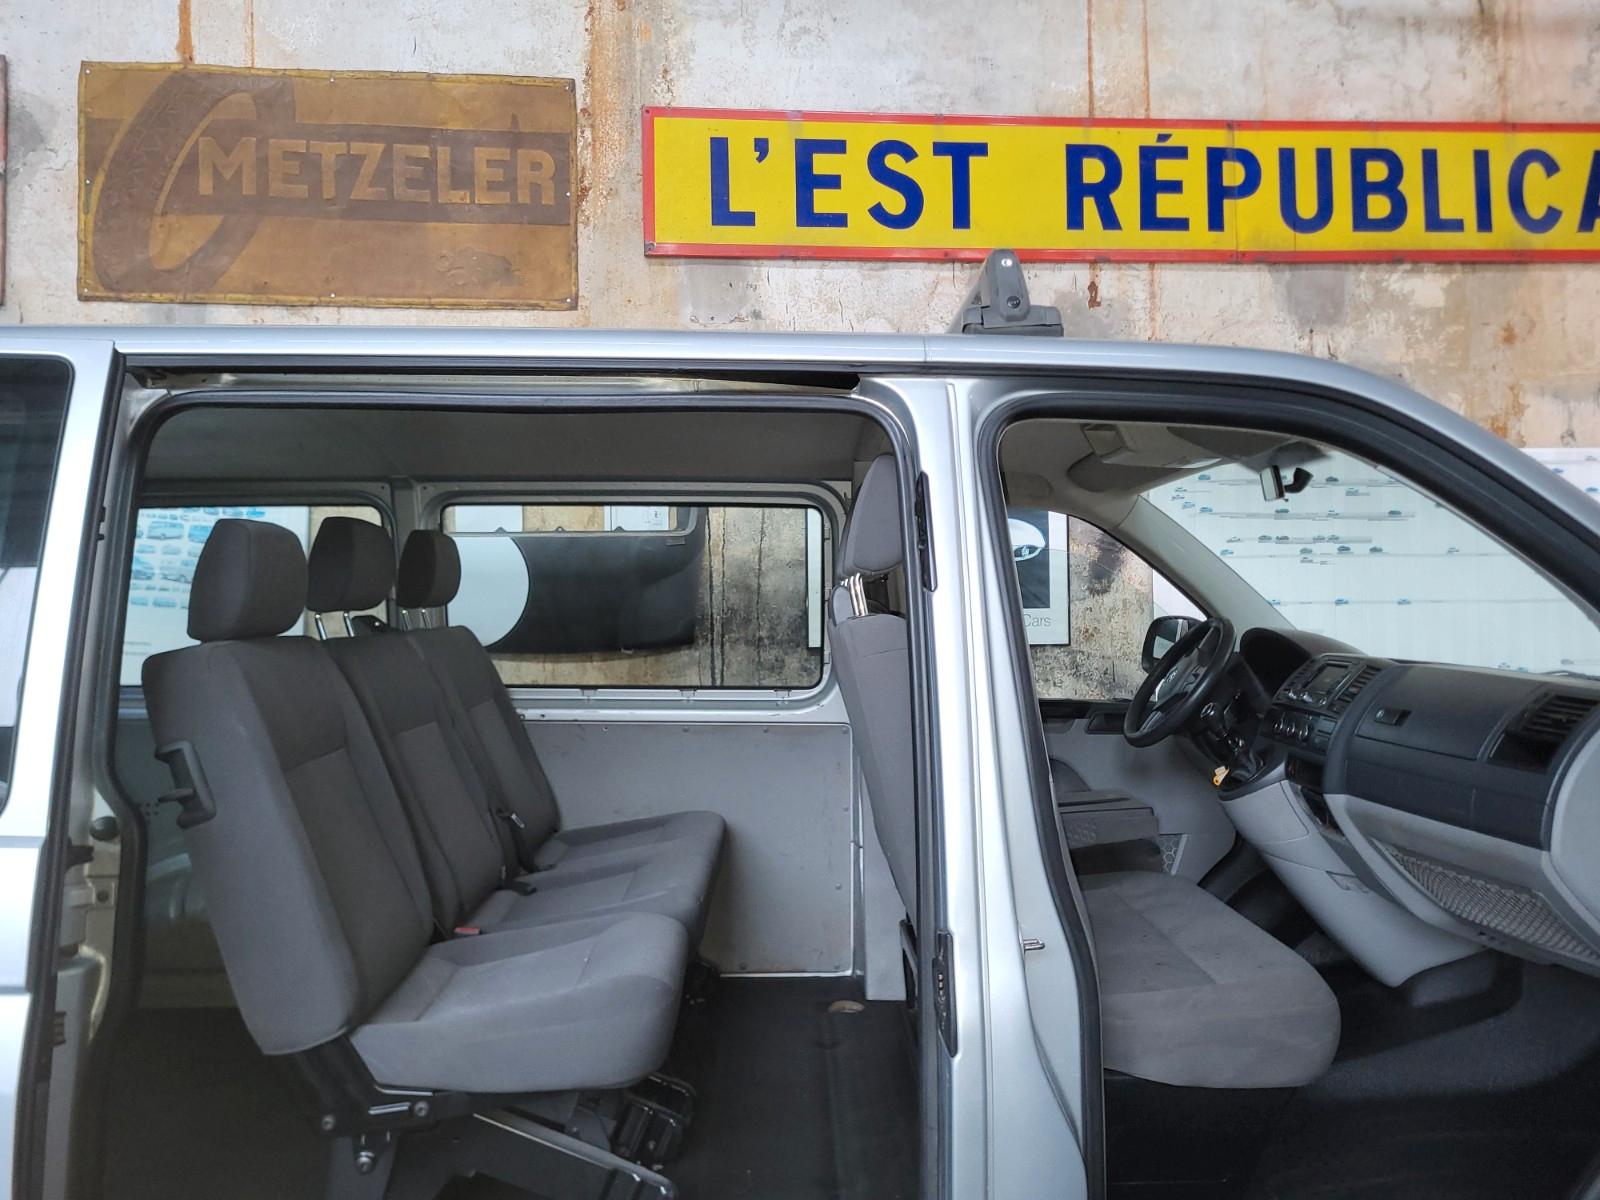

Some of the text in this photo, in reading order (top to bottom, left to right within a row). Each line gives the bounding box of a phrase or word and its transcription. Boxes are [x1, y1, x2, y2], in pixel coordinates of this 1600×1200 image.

[198, 136, 556, 205] METZELER
[709, 137, 989, 230] L'EST
[1023, 613, 1052, 628] Cars
